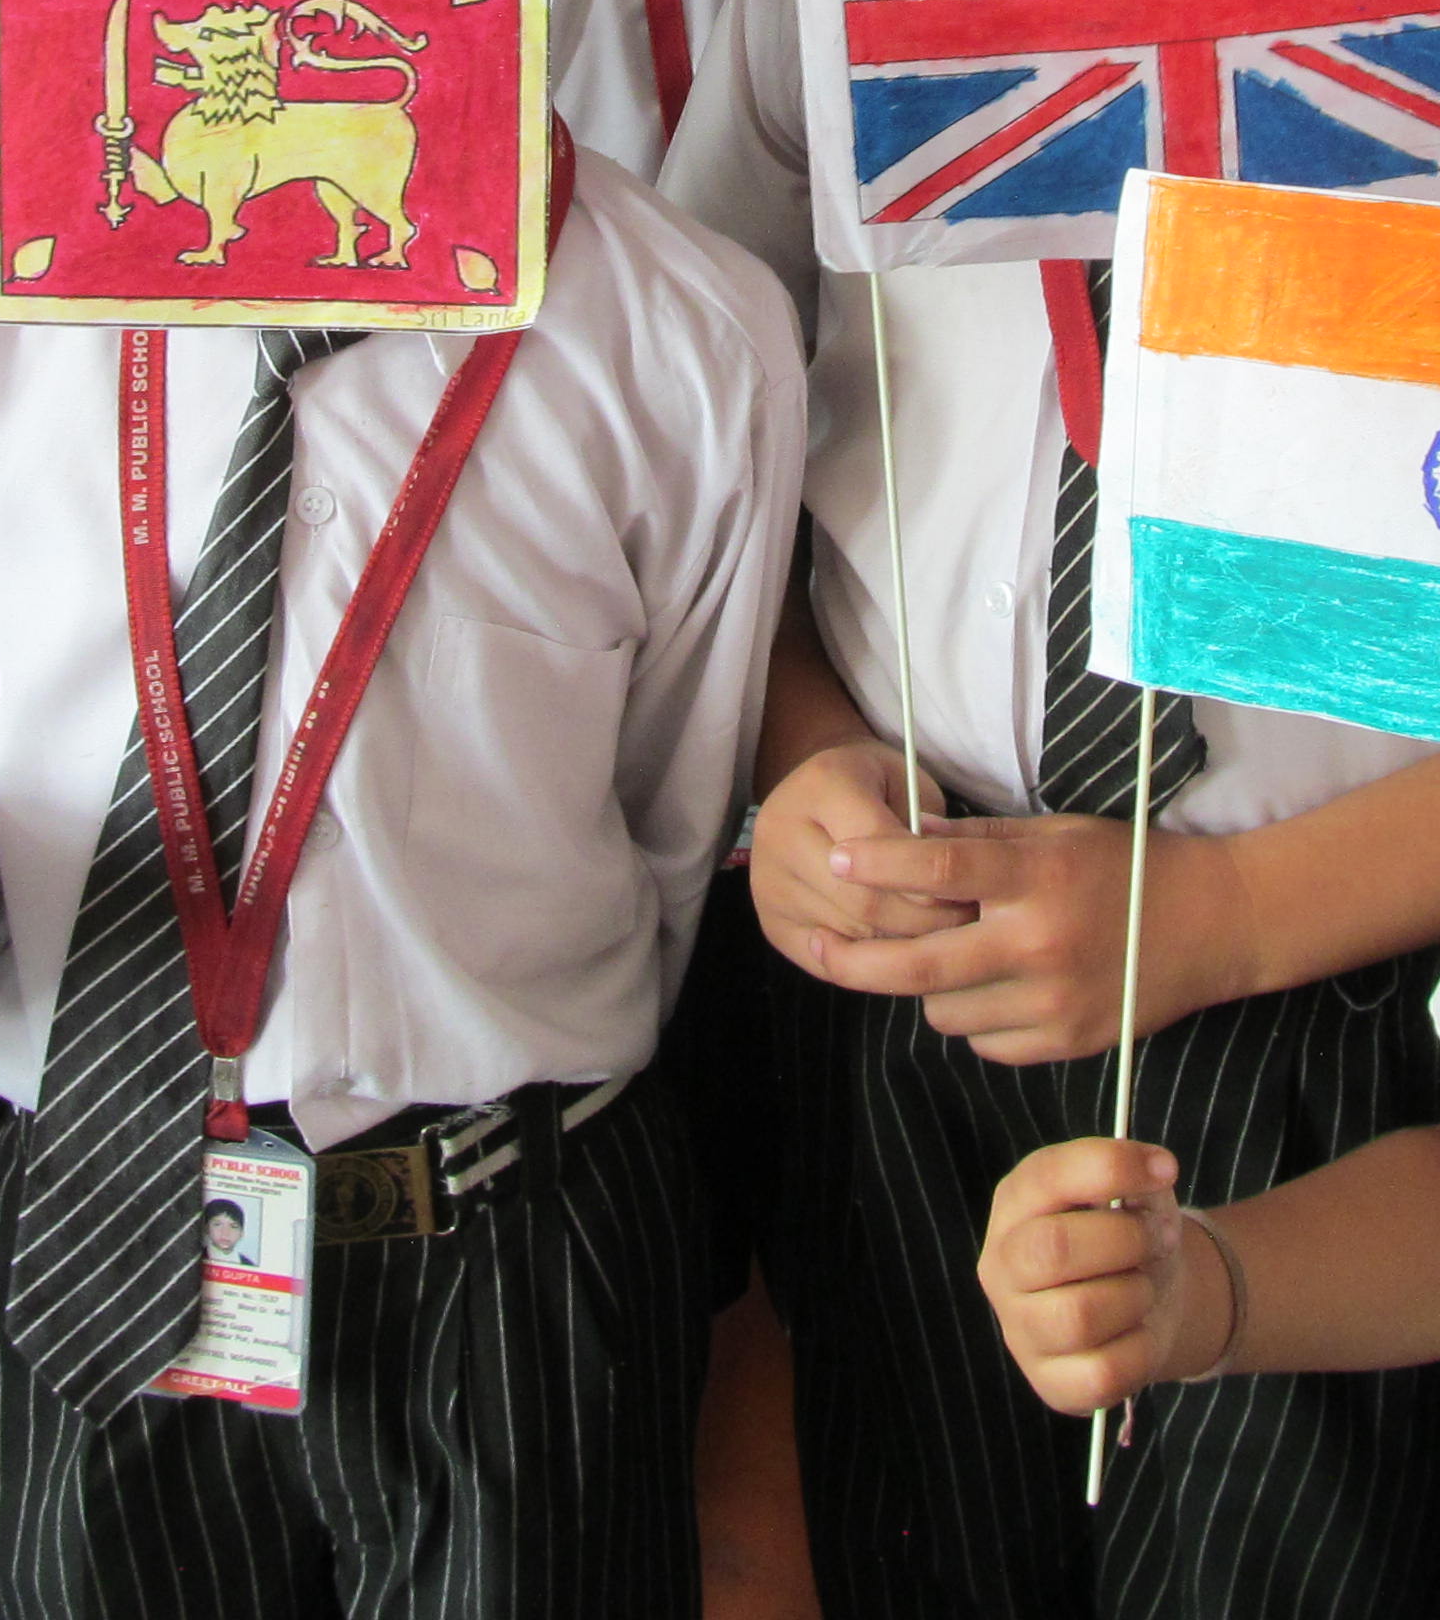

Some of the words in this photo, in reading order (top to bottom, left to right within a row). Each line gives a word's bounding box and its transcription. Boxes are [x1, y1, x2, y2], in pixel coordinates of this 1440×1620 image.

[416, 310, 448, 326] Sri
[460, 309, 527, 328] Lanka
[132, 331, 149, 393] SCHO
[131, 398, 149, 481] PUBLIC
[131, 486, 148, 512] M.
[133, 518, 150, 545] M.
[145, 649, 175, 744] SCHOOL
[164, 749, 192, 831] PUBLIC
[212, 1157, 254, 1174] PUBLIC
[256, 1164, 303, 1182] SCHOOL
